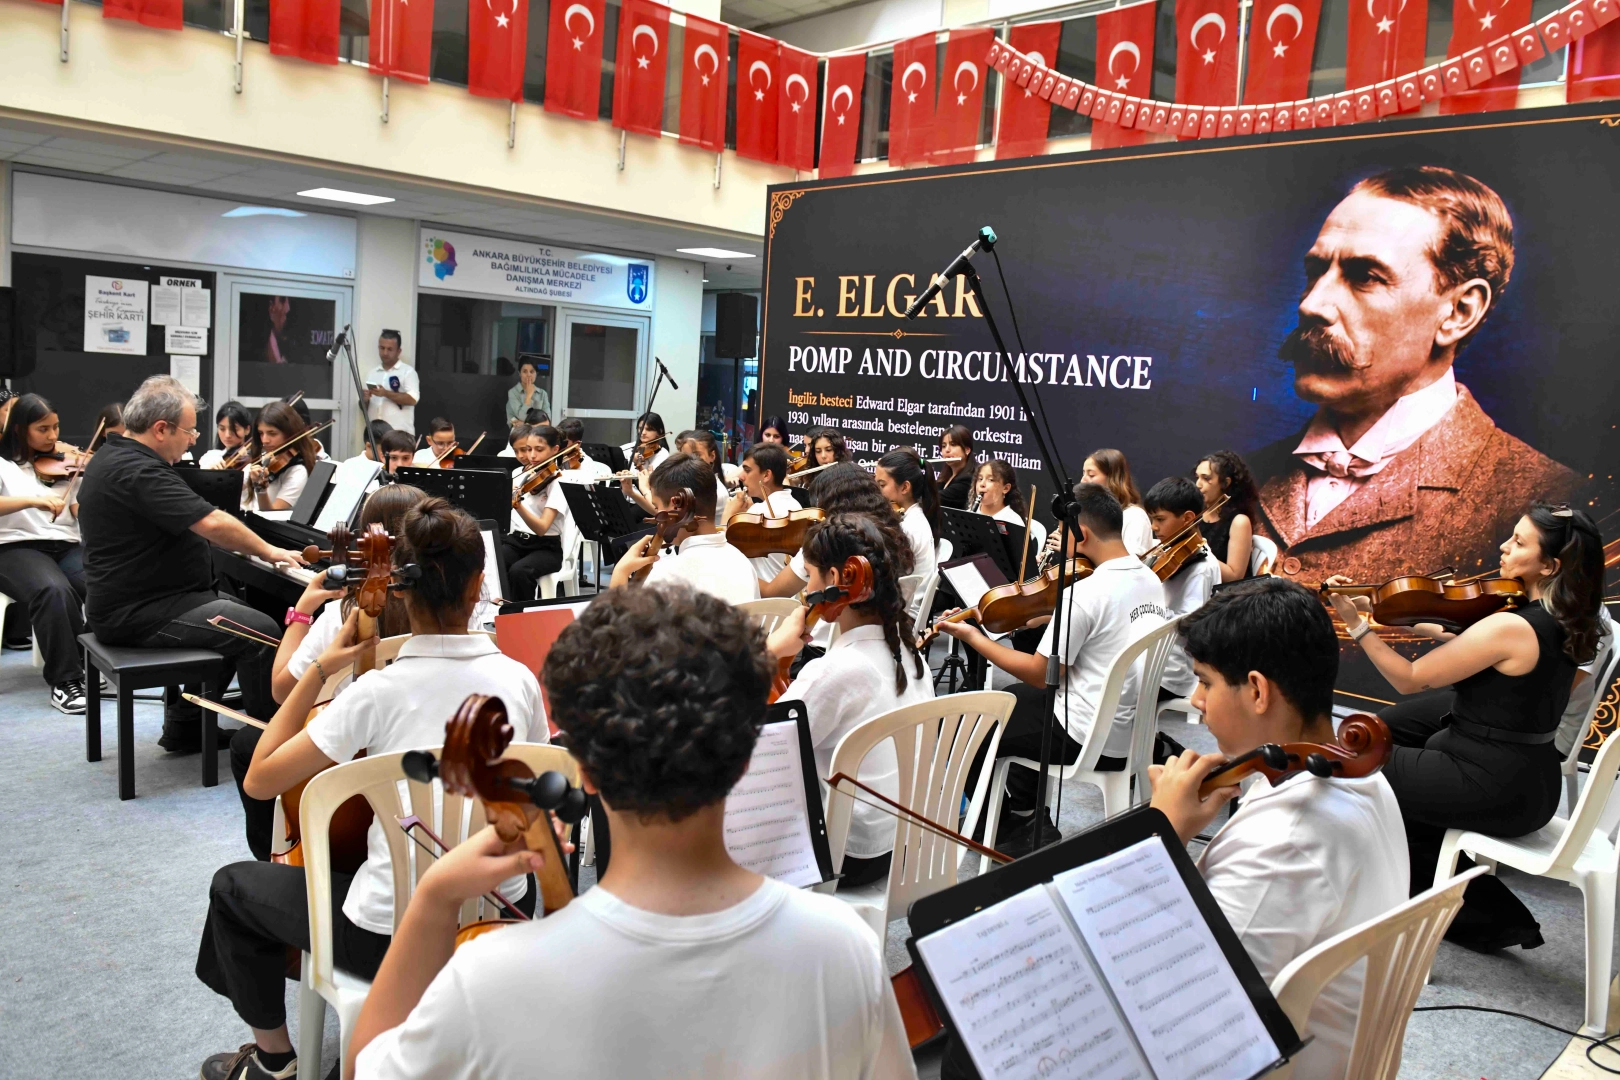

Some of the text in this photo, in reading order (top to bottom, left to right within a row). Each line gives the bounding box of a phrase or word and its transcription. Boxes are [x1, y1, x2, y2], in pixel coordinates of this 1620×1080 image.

[472, 249, 613, 275] ANKARA BÜYÜKŞEHİR BELEDİYESİ
[491, 261, 596, 282] BAĞIMLILIKLA MÜCADELE
[506, 273, 582, 290] DANIŞMA MERKEZİ
[515, 285, 573, 298] ALTINDAĞ ŞUBESİ
[793, 272, 984, 318] E. ELGAR
[88, 310, 144, 322] ŞEHİR KARTI
[788, 345, 1153, 391] POMP AND CIRCUMSTANCE
[788, 387, 818, 408] İngiliz
[819, 393, 854, 409] besteci
[855, 395, 895, 412] Edward
[897, 398, 926, 417] Elgar
[928, 402, 985, 419] tarafından
[989, 404, 1016, 421] 1901
[787, 410, 810, 425] 1930
[812, 413, 840, 428] yılları
[842, 417, 884, 432] arasında
[972, 427, 1023, 445] orkestra
[871, 438, 887, 454] bir
[1130, 607, 1139, 623] HER
